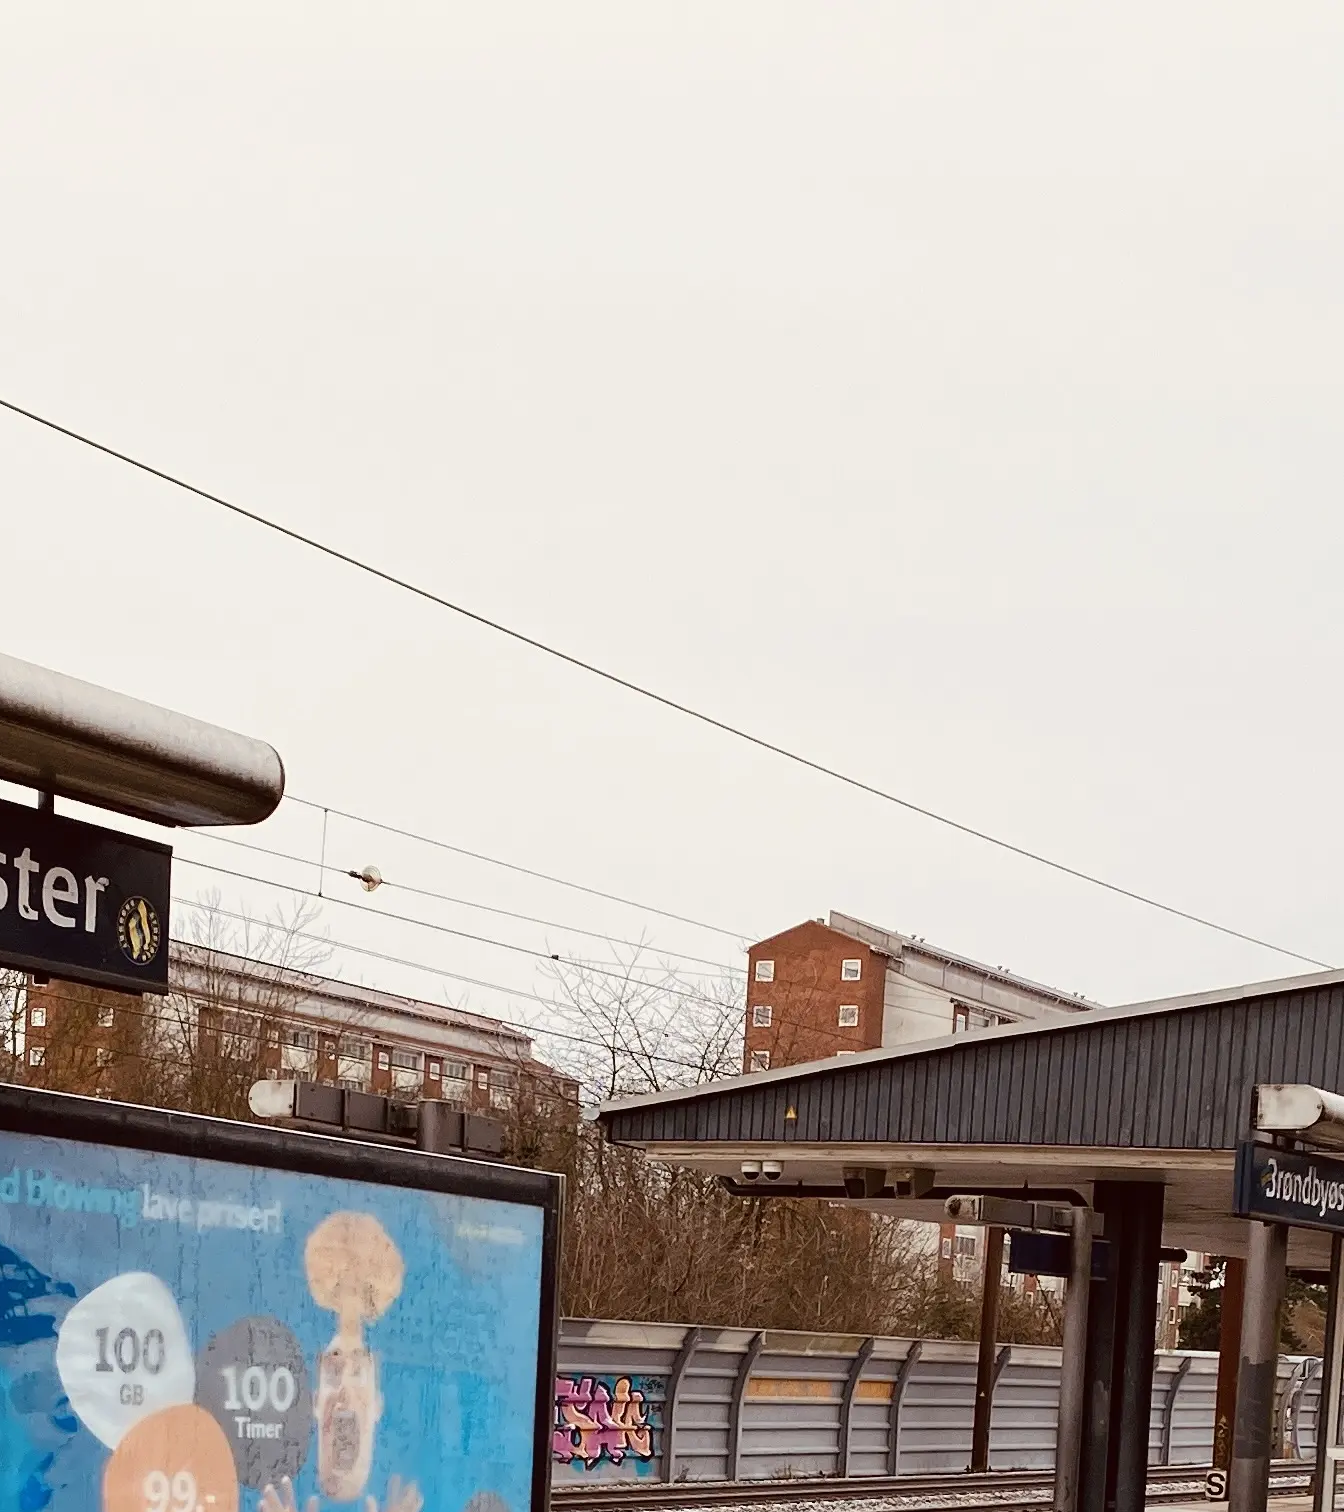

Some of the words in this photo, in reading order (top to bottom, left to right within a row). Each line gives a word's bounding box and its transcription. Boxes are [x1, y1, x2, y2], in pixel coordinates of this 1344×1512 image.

[95, 1326, 166, 1375] 100
[119, 1383, 145, 1406] GB
[220, 1365, 296, 1412] 100
[234, 1416, 283, 1440] Timer
[1206, 1472, 1226, 1496] S
